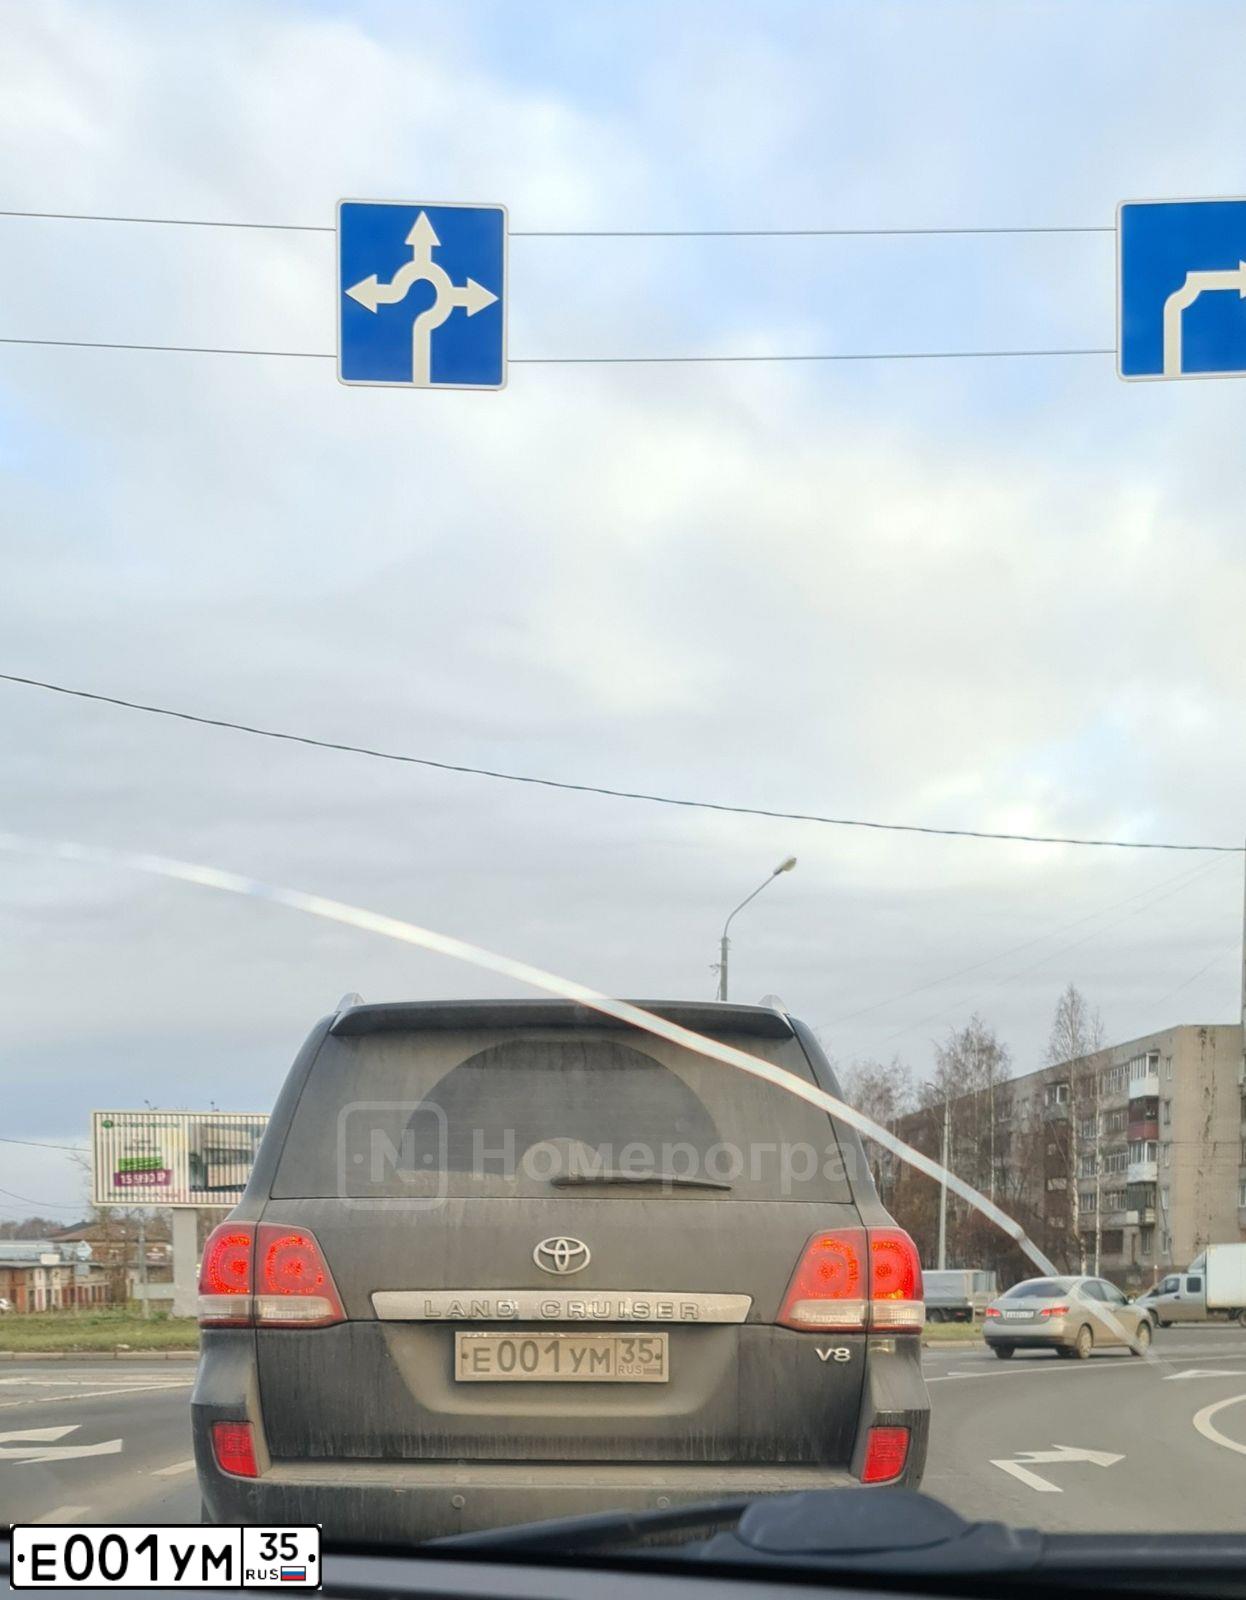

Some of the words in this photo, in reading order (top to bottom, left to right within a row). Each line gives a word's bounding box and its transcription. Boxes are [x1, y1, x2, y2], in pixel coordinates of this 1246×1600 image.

[424, 1299, 517, 1318] LAND
[540, 1299, 700, 1320] CRUISER
[621, 1339, 654, 1364] 35
[814, 1347, 852, 1363] V8
[617, 1365, 642, 1375] RUS
